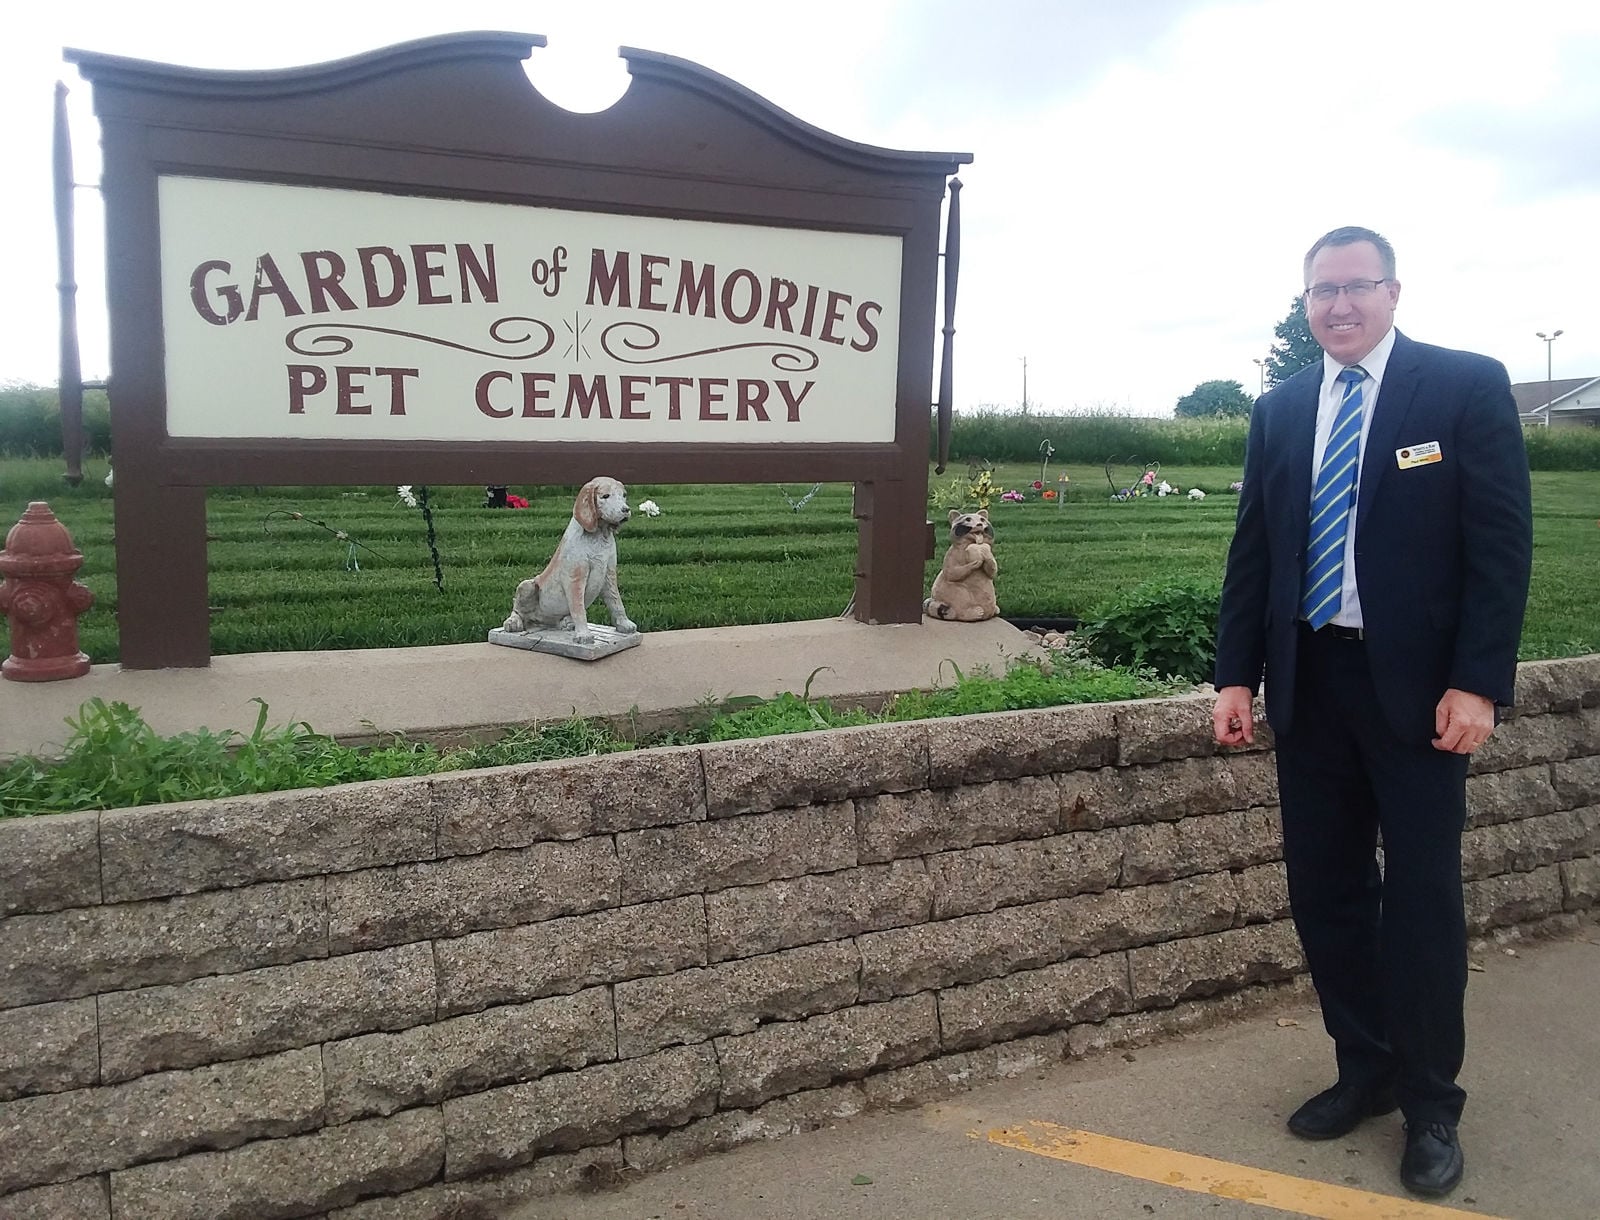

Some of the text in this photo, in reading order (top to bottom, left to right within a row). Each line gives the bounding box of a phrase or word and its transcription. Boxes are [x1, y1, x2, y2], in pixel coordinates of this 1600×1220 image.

[190, 244, 883, 353] GARDEN of MEMORIES
[286, 365, 816, 423] PET CEMETERY
